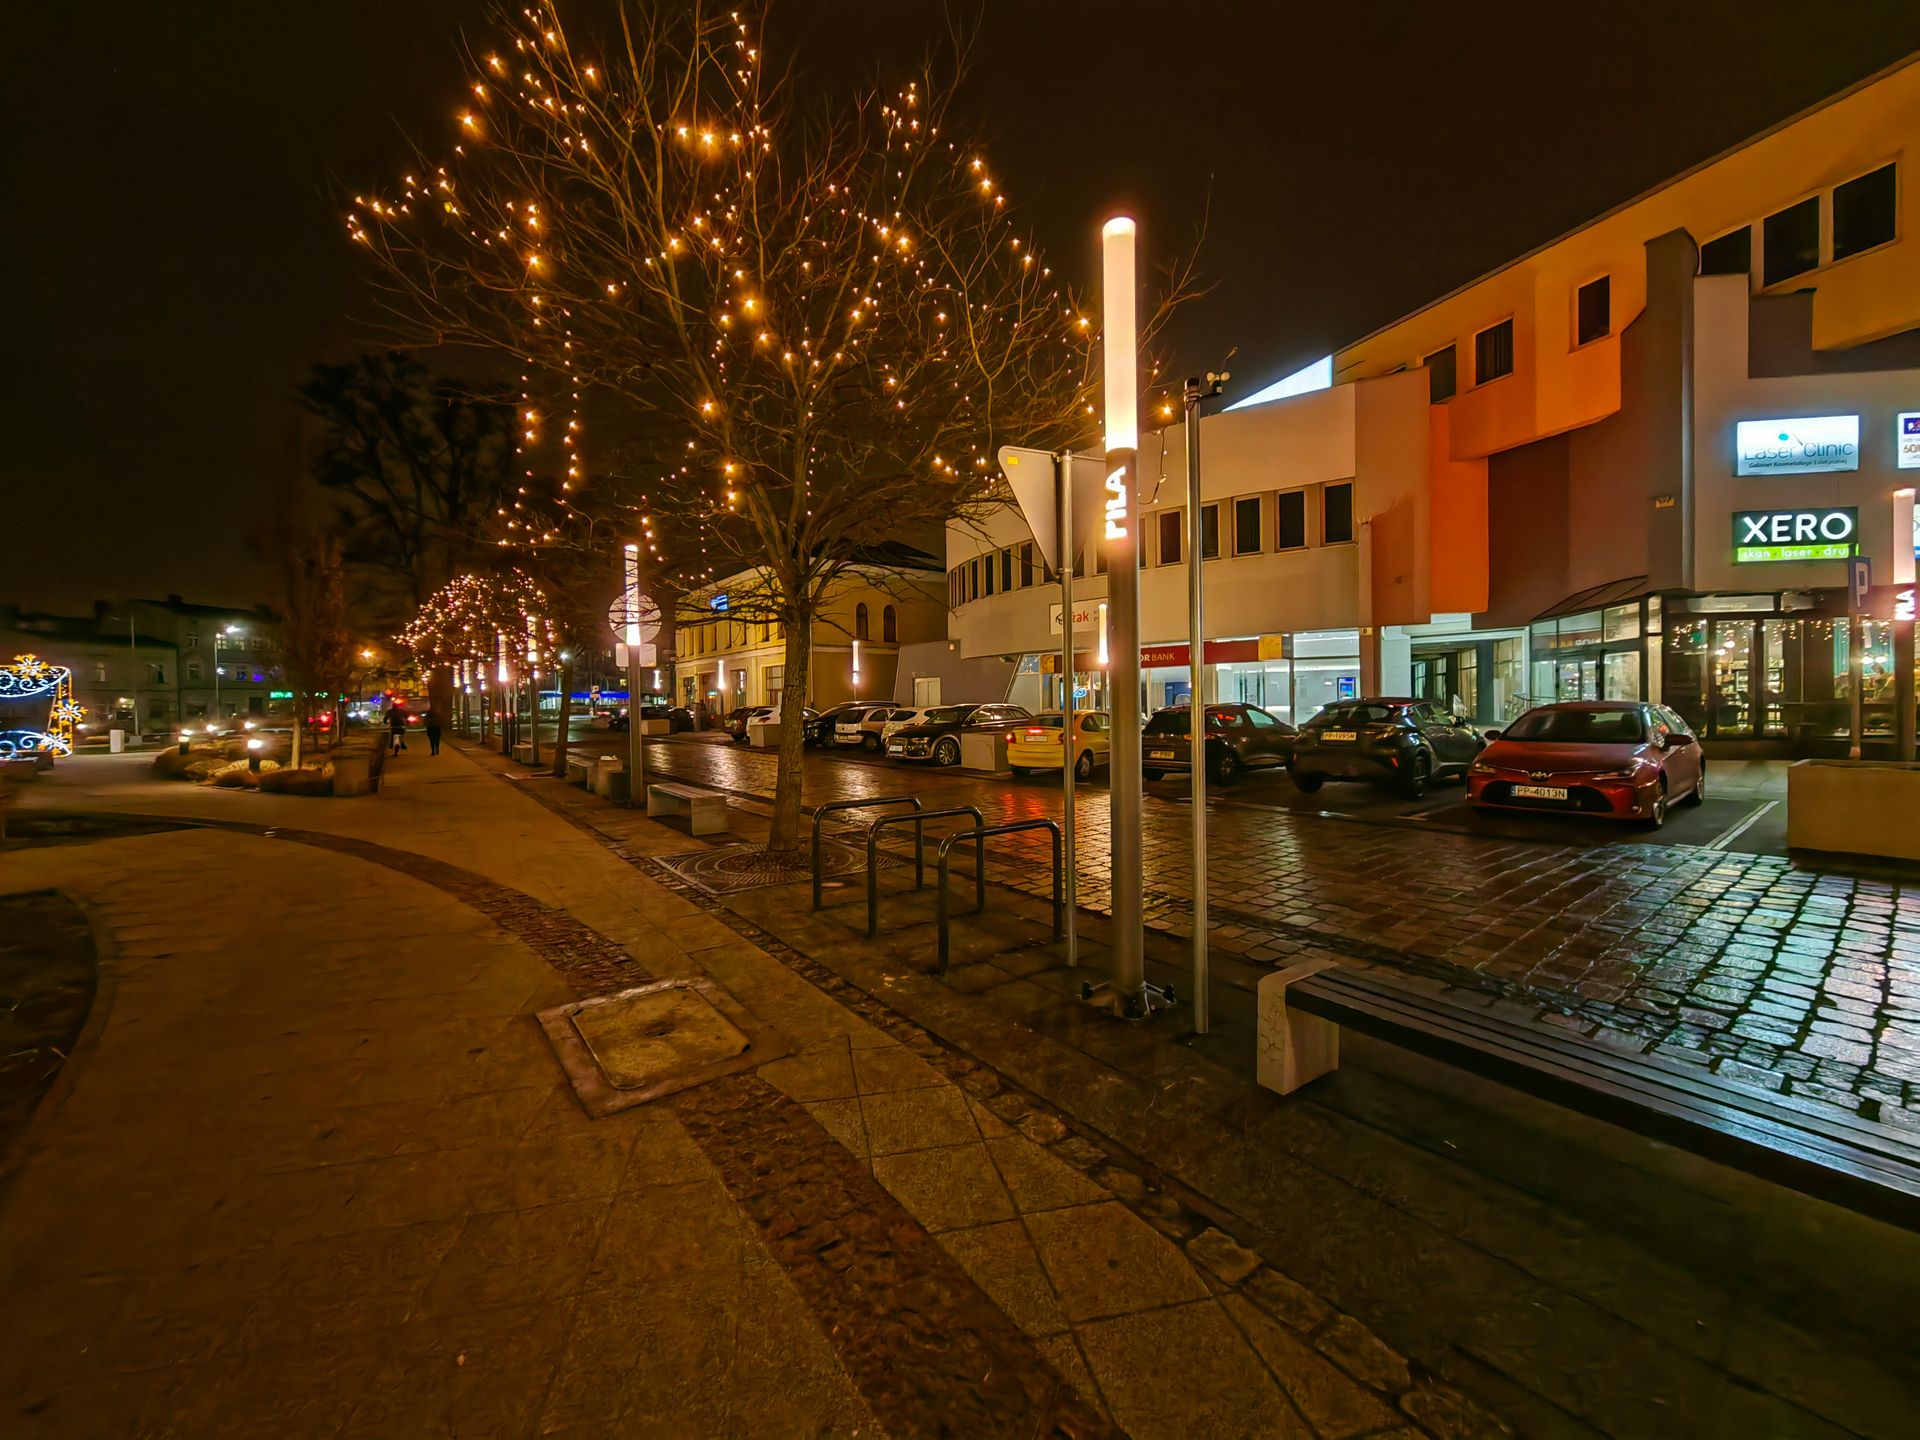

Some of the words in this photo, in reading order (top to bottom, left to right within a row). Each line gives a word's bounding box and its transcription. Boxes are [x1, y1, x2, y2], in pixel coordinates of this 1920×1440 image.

[1744, 446, 1797, 461] Laser
[1803, 441, 1854, 457] Clinic
[1743, 512, 1852, 543] XERO
[1781, 547, 1812, 557] laser
[1824, 545, 1849, 557] dru
[1151, 652, 1175, 661] BANK
